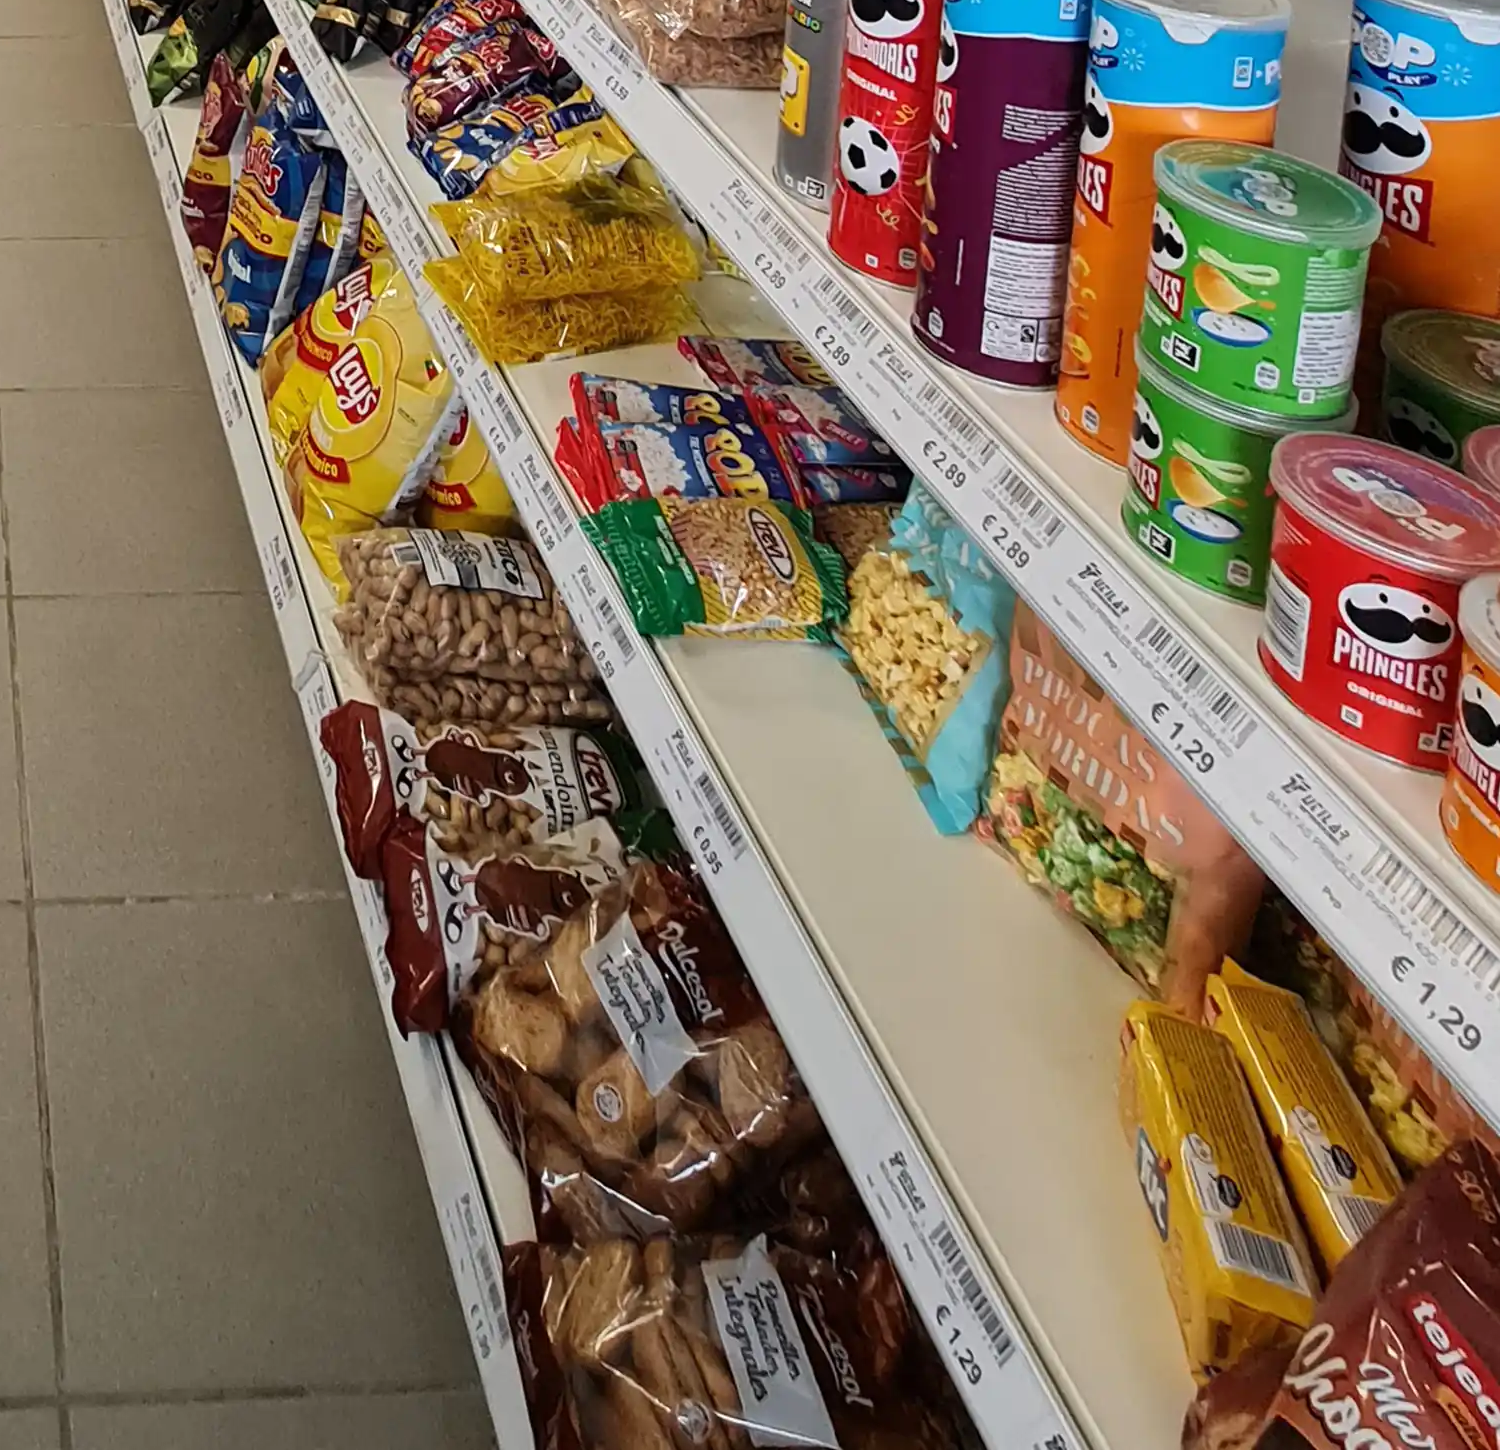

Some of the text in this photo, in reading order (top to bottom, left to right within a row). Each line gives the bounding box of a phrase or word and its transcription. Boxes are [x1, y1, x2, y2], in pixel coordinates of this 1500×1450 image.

[754, 252, 788, 290] € 2,89
[813, 324, 852, 367] € 2,89
[328, 342, 382, 426] Lay's
[921, 440, 968, 489] € 2,89
[981, 513, 1031, 569] € 2,89
[597, 648, 616, 679] 0,59
[1332, 626, 1449, 703] PRINGLES
[1023, 654, 1157, 783] PIPOCAS
[1151, 701, 1215, 775] € 1,29
[691, 823, 724, 876] € 0,95
[1311, 834, 1366, 892] PRINGLES
[658, 919, 727, 1026] Dulcesol
[1389, 954, 1483, 1052] € 1,29
[1138, 1148, 1167, 1233] TUC
[934, 1303, 983, 1387] € 1,29
